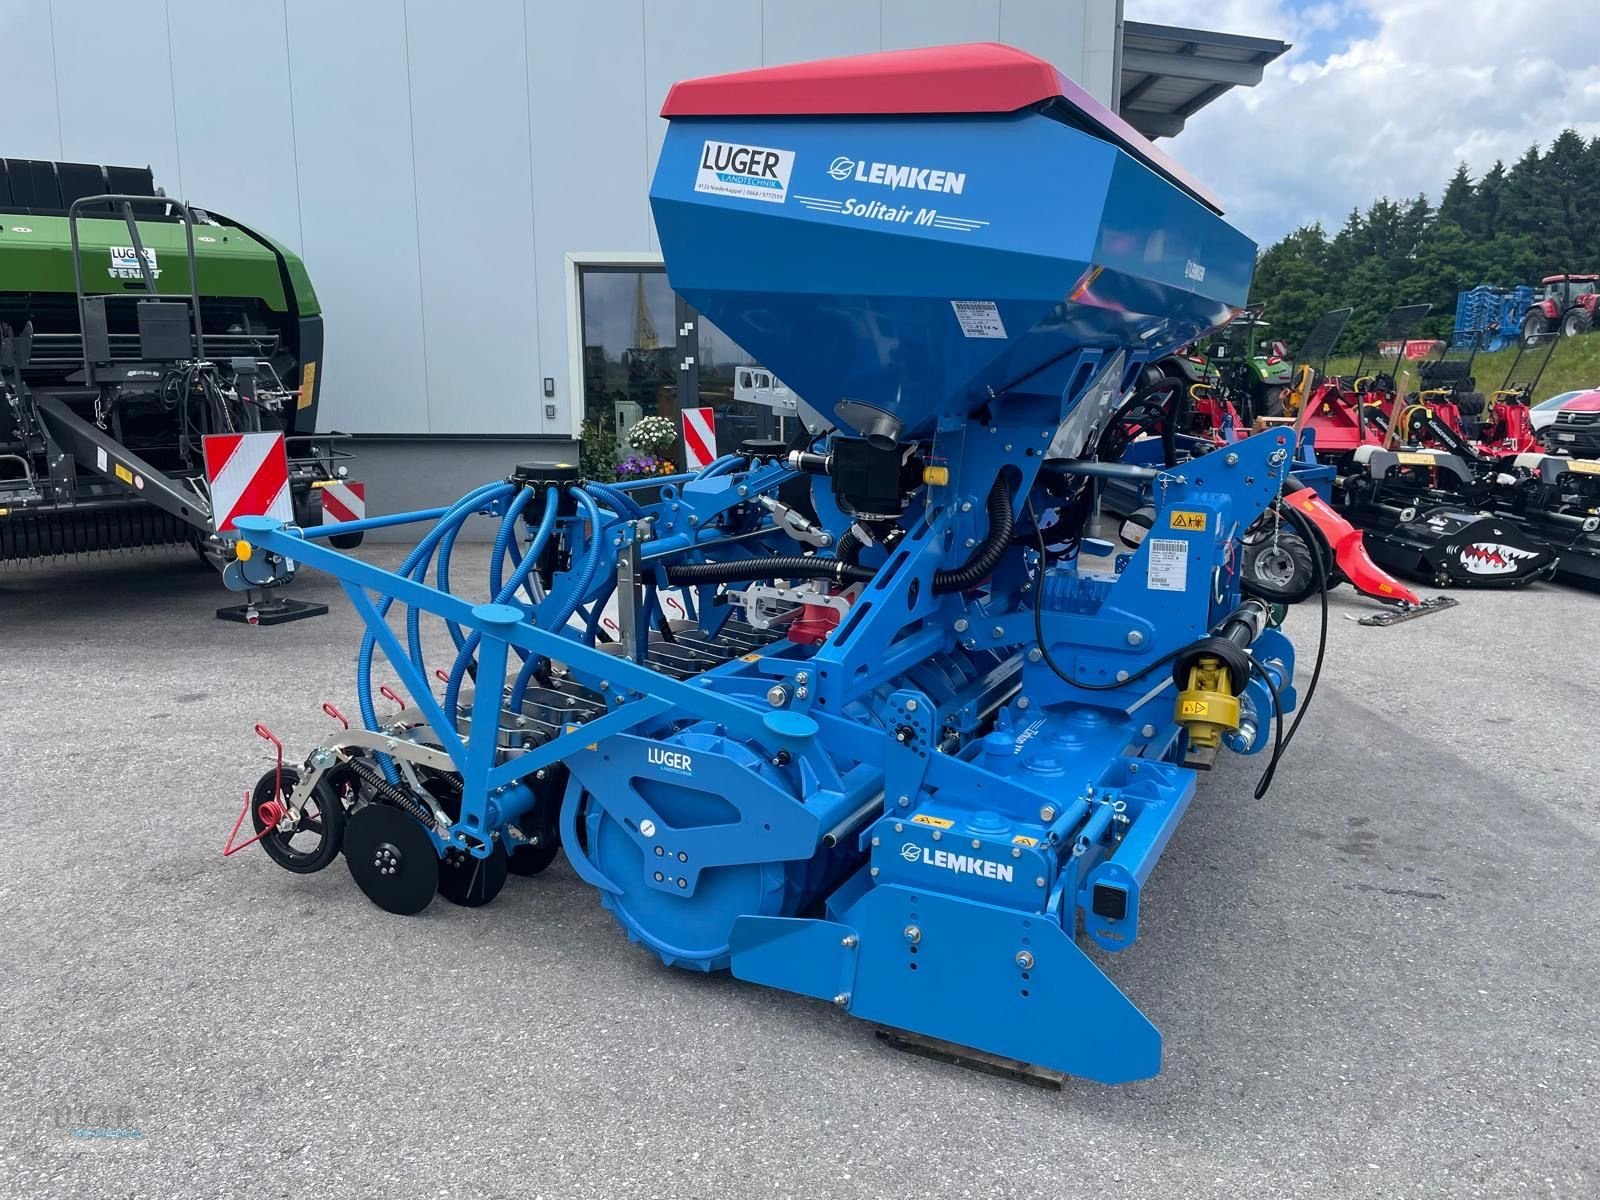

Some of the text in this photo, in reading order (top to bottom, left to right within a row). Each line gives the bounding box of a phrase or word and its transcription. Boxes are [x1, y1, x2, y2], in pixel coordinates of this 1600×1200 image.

[702, 144, 780, 179] LUGER
[721, 174, 777, 188] LANDTECHNIK
[854, 160, 967, 195] LEMKEN
[841, 198, 937, 228] Solitair M
[112, 248, 150, 260] LUGR
[108, 267, 163, 280] FENT
[647, 747, 692, 772] LUGER
[923, 847, 1013, 883] LEMKEN
